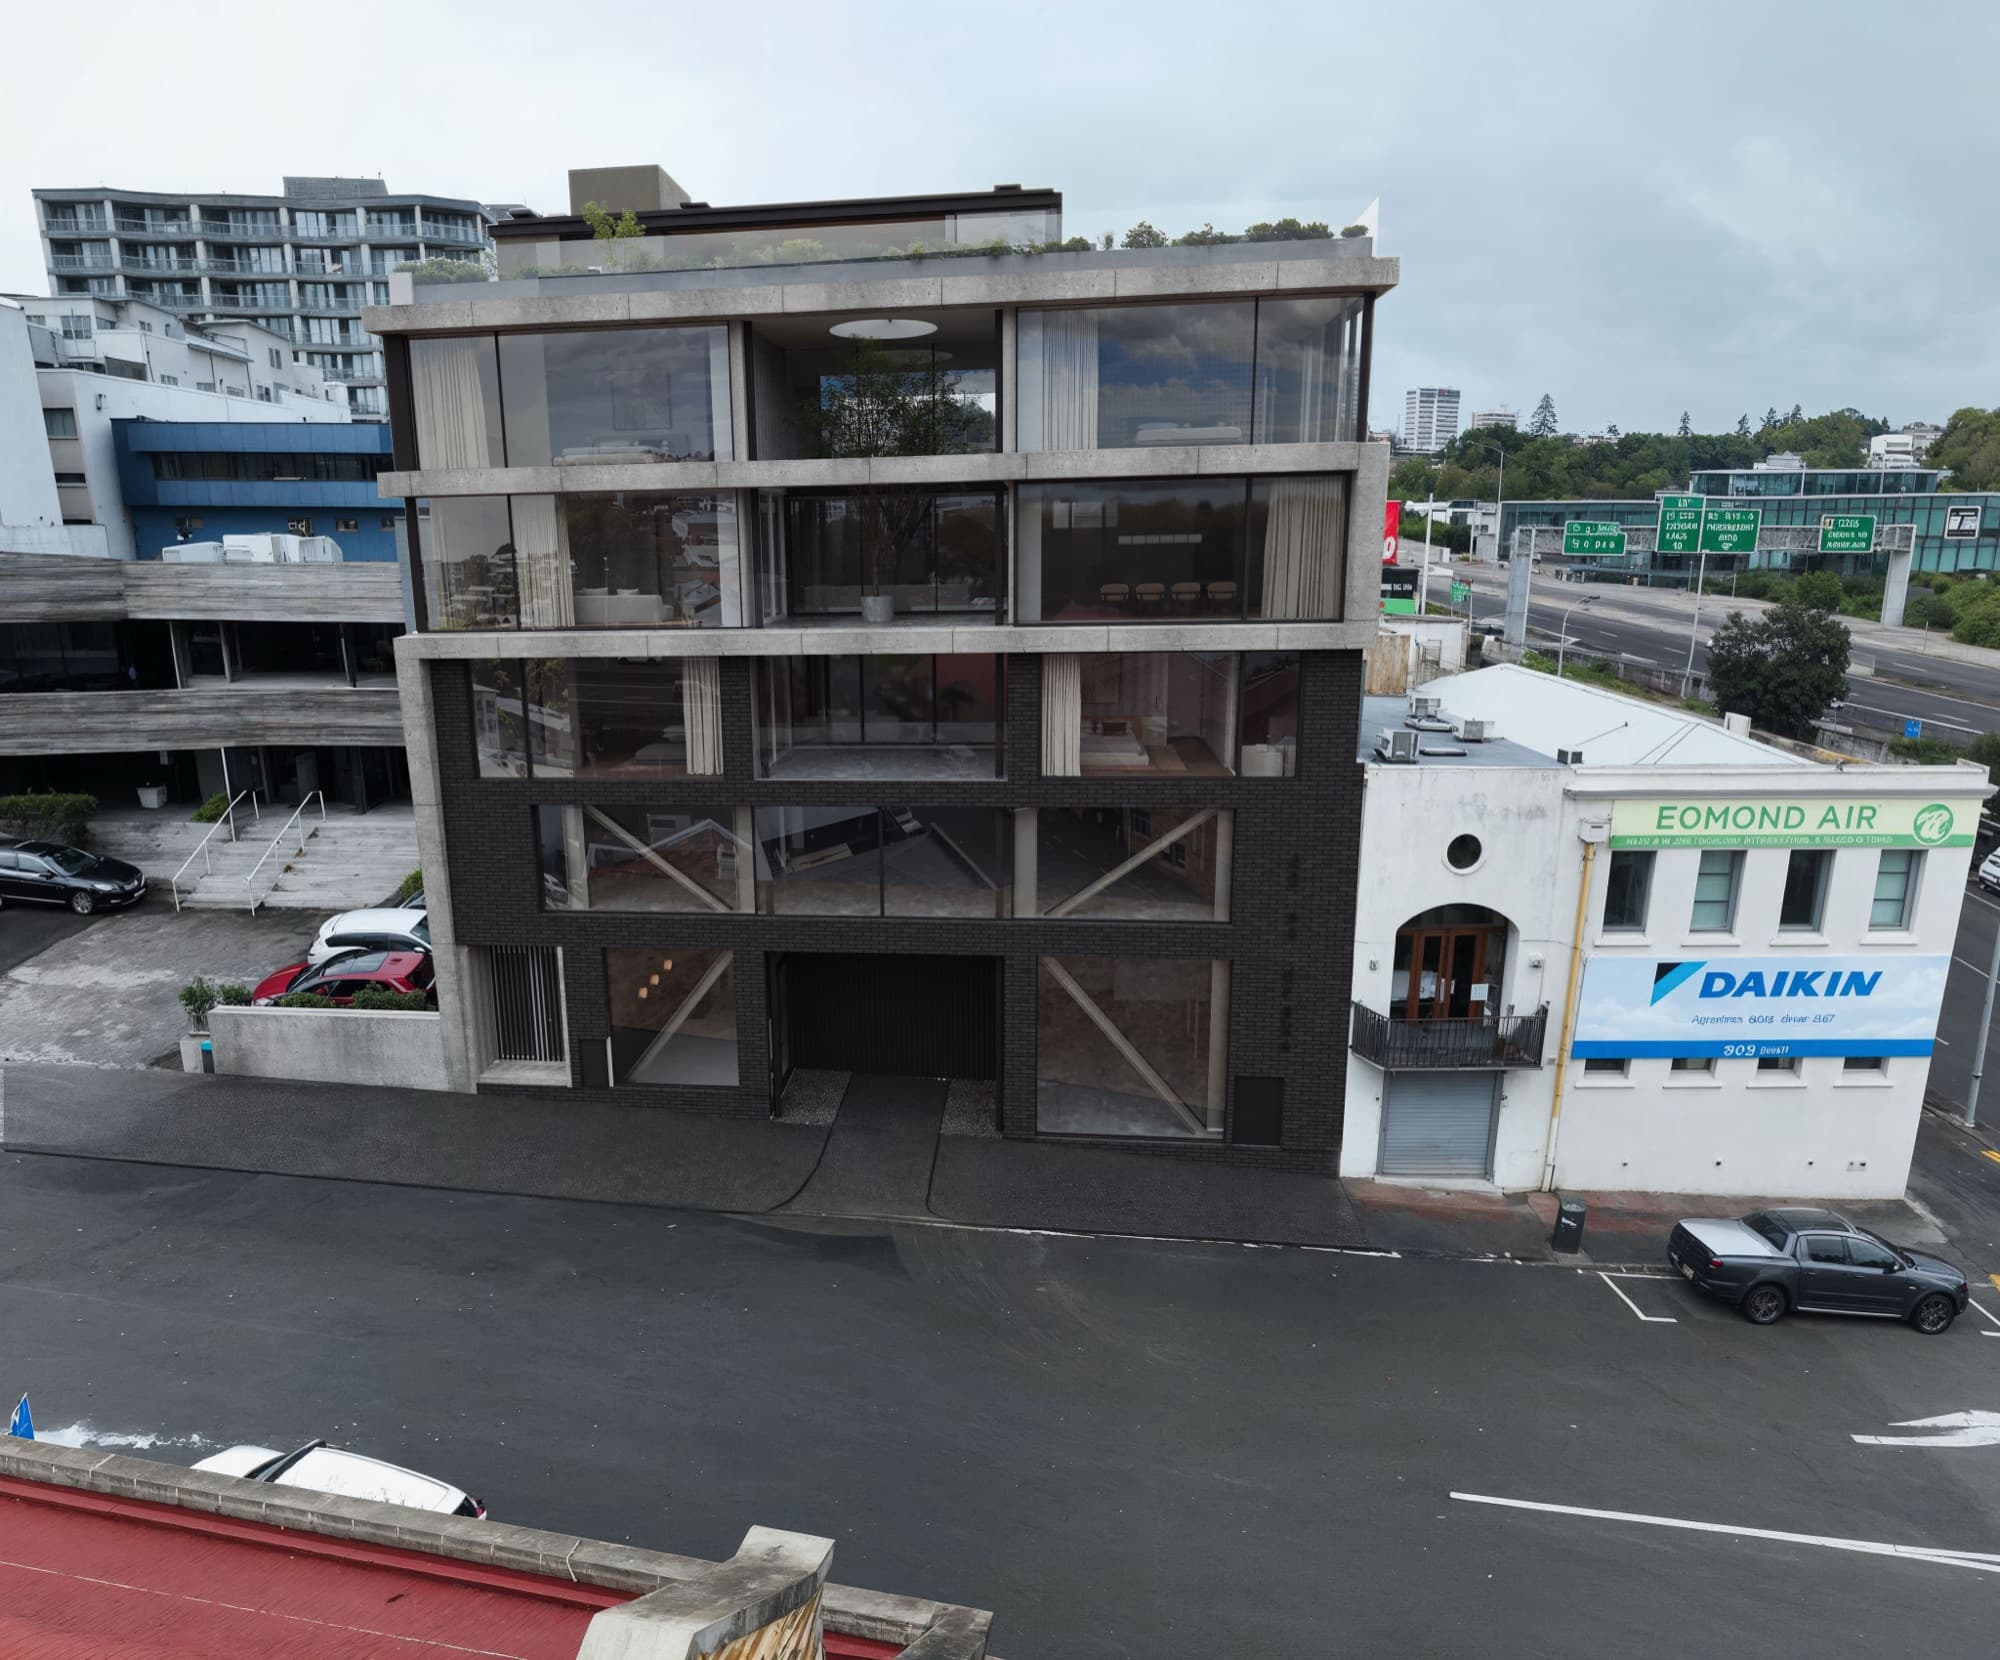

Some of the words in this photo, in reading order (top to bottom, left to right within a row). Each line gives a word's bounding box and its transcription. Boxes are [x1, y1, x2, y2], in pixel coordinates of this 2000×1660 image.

[1656, 805, 1806, 830] EOMOND
[1816, 805, 1878, 830] AIR
[1699, 971, 1883, 998] DAIKIN
